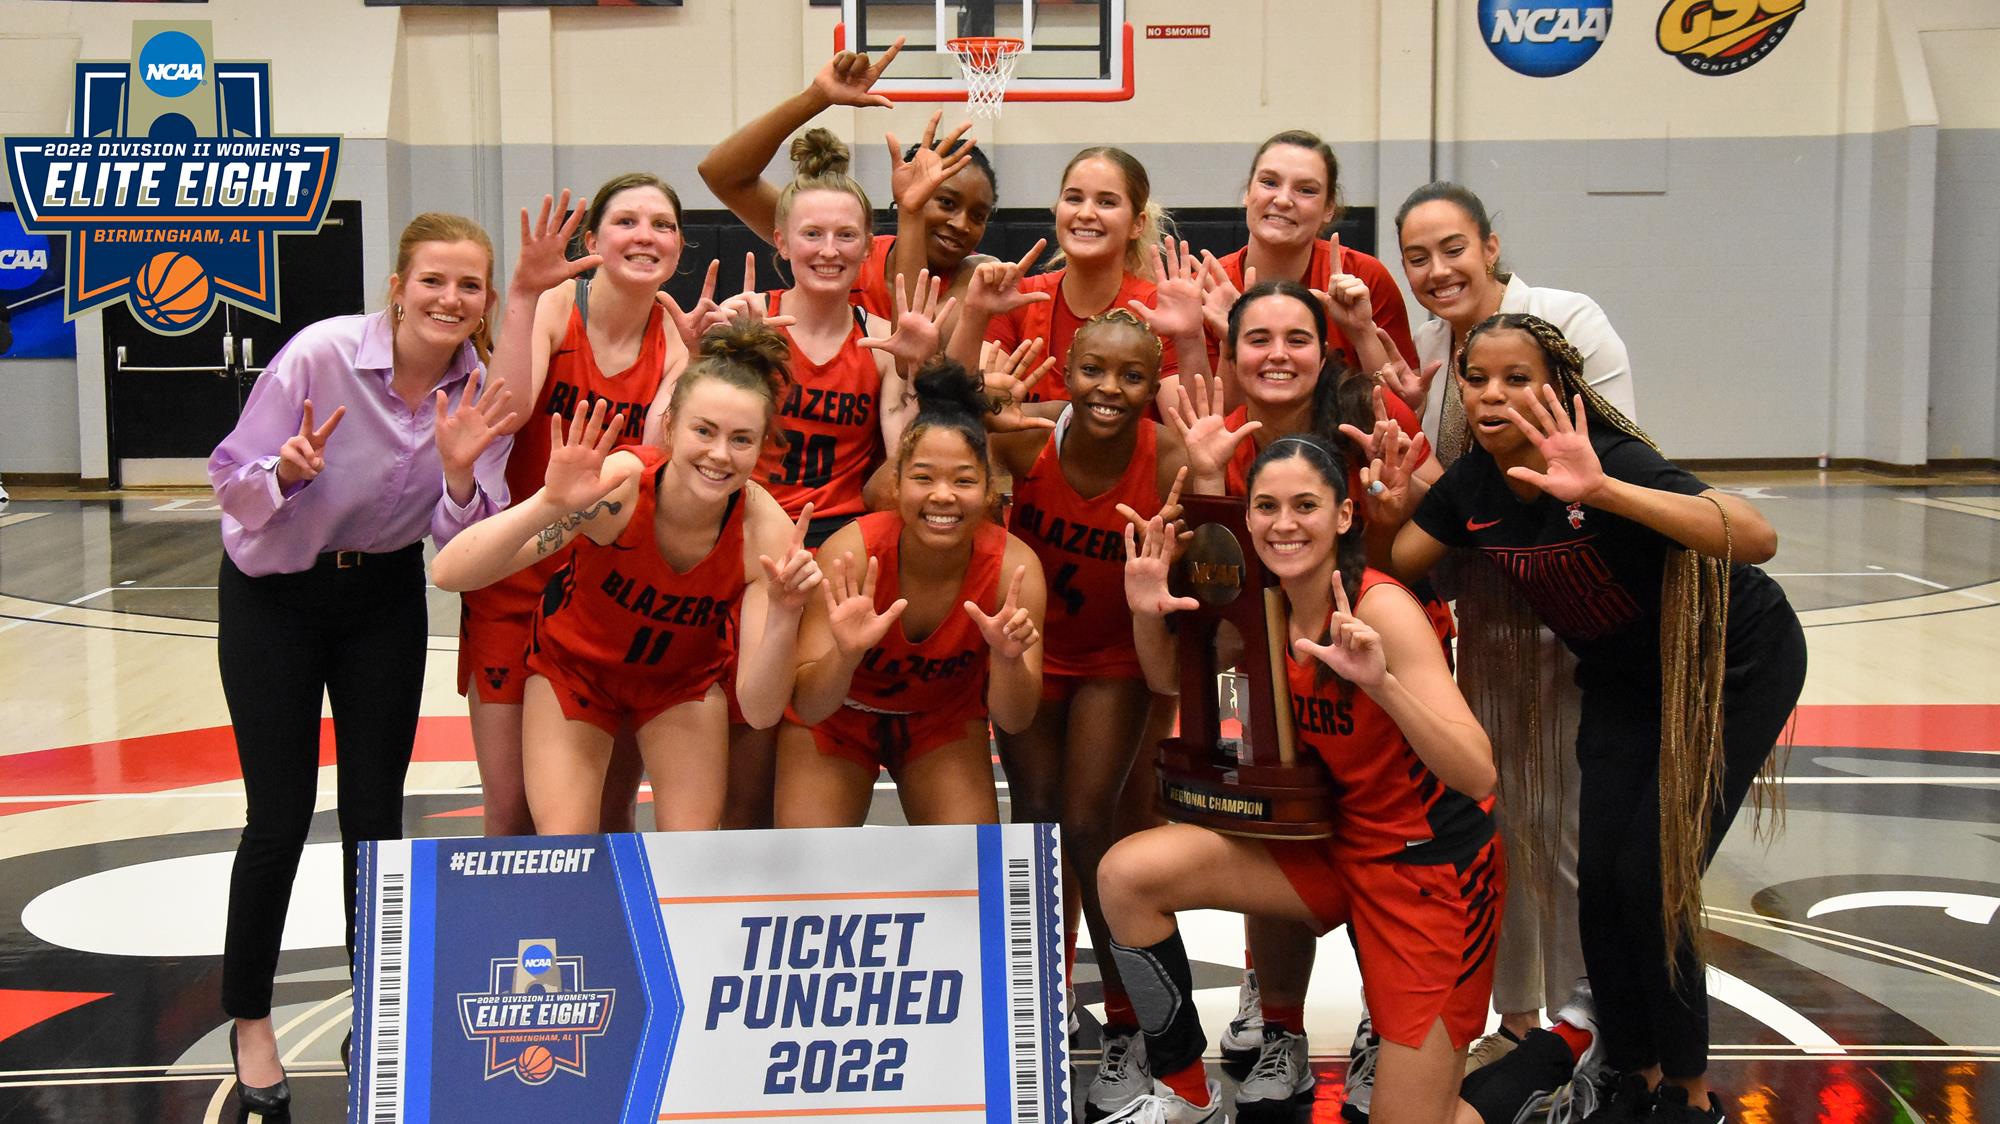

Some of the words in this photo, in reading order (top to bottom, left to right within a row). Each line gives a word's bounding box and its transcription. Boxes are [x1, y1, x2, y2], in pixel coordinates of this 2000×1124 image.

[1148, 27, 1162, 36] NO
[1165, 27, 1209, 36] SMOKING
[1491, 8, 1606, 43] NCAA
[1691, 25, 1785, 71] CONFERENCE
[0, 249, 48, 270] CAA
[780, 384, 872, 427] AZERS
[769, 429, 837, 489] 30
[601, 568, 729, 627] BLAZERS
[624, 626, 674, 665] 11
[1294, 693, 1354, 736] ZERS
[1170, 787, 1208, 808] REGIONAL
[1208, 796, 1264, 816] CHAMPION
[450, 848, 596, 876] #ELITEEIGHT
[741, 913, 926, 971] TICKET
[524, 958, 552, 968] NCAA
[475, 1003, 534, 1028] ELITE
[537, 1001, 601, 1026] EIGHT
[477, 996, 501, 1004] 2022
[502, 995, 544, 1003] DIVISION
[545, 994, 554, 1003] II
[556, 993, 596, 1001] WOMEN'S
[705, 969, 964, 1031] PUNCHED
[499, 1034, 560, 1043] BIRMINGHAM,
[562, 1034, 573, 1042] AL
[763, 1038, 909, 1094] 2022
